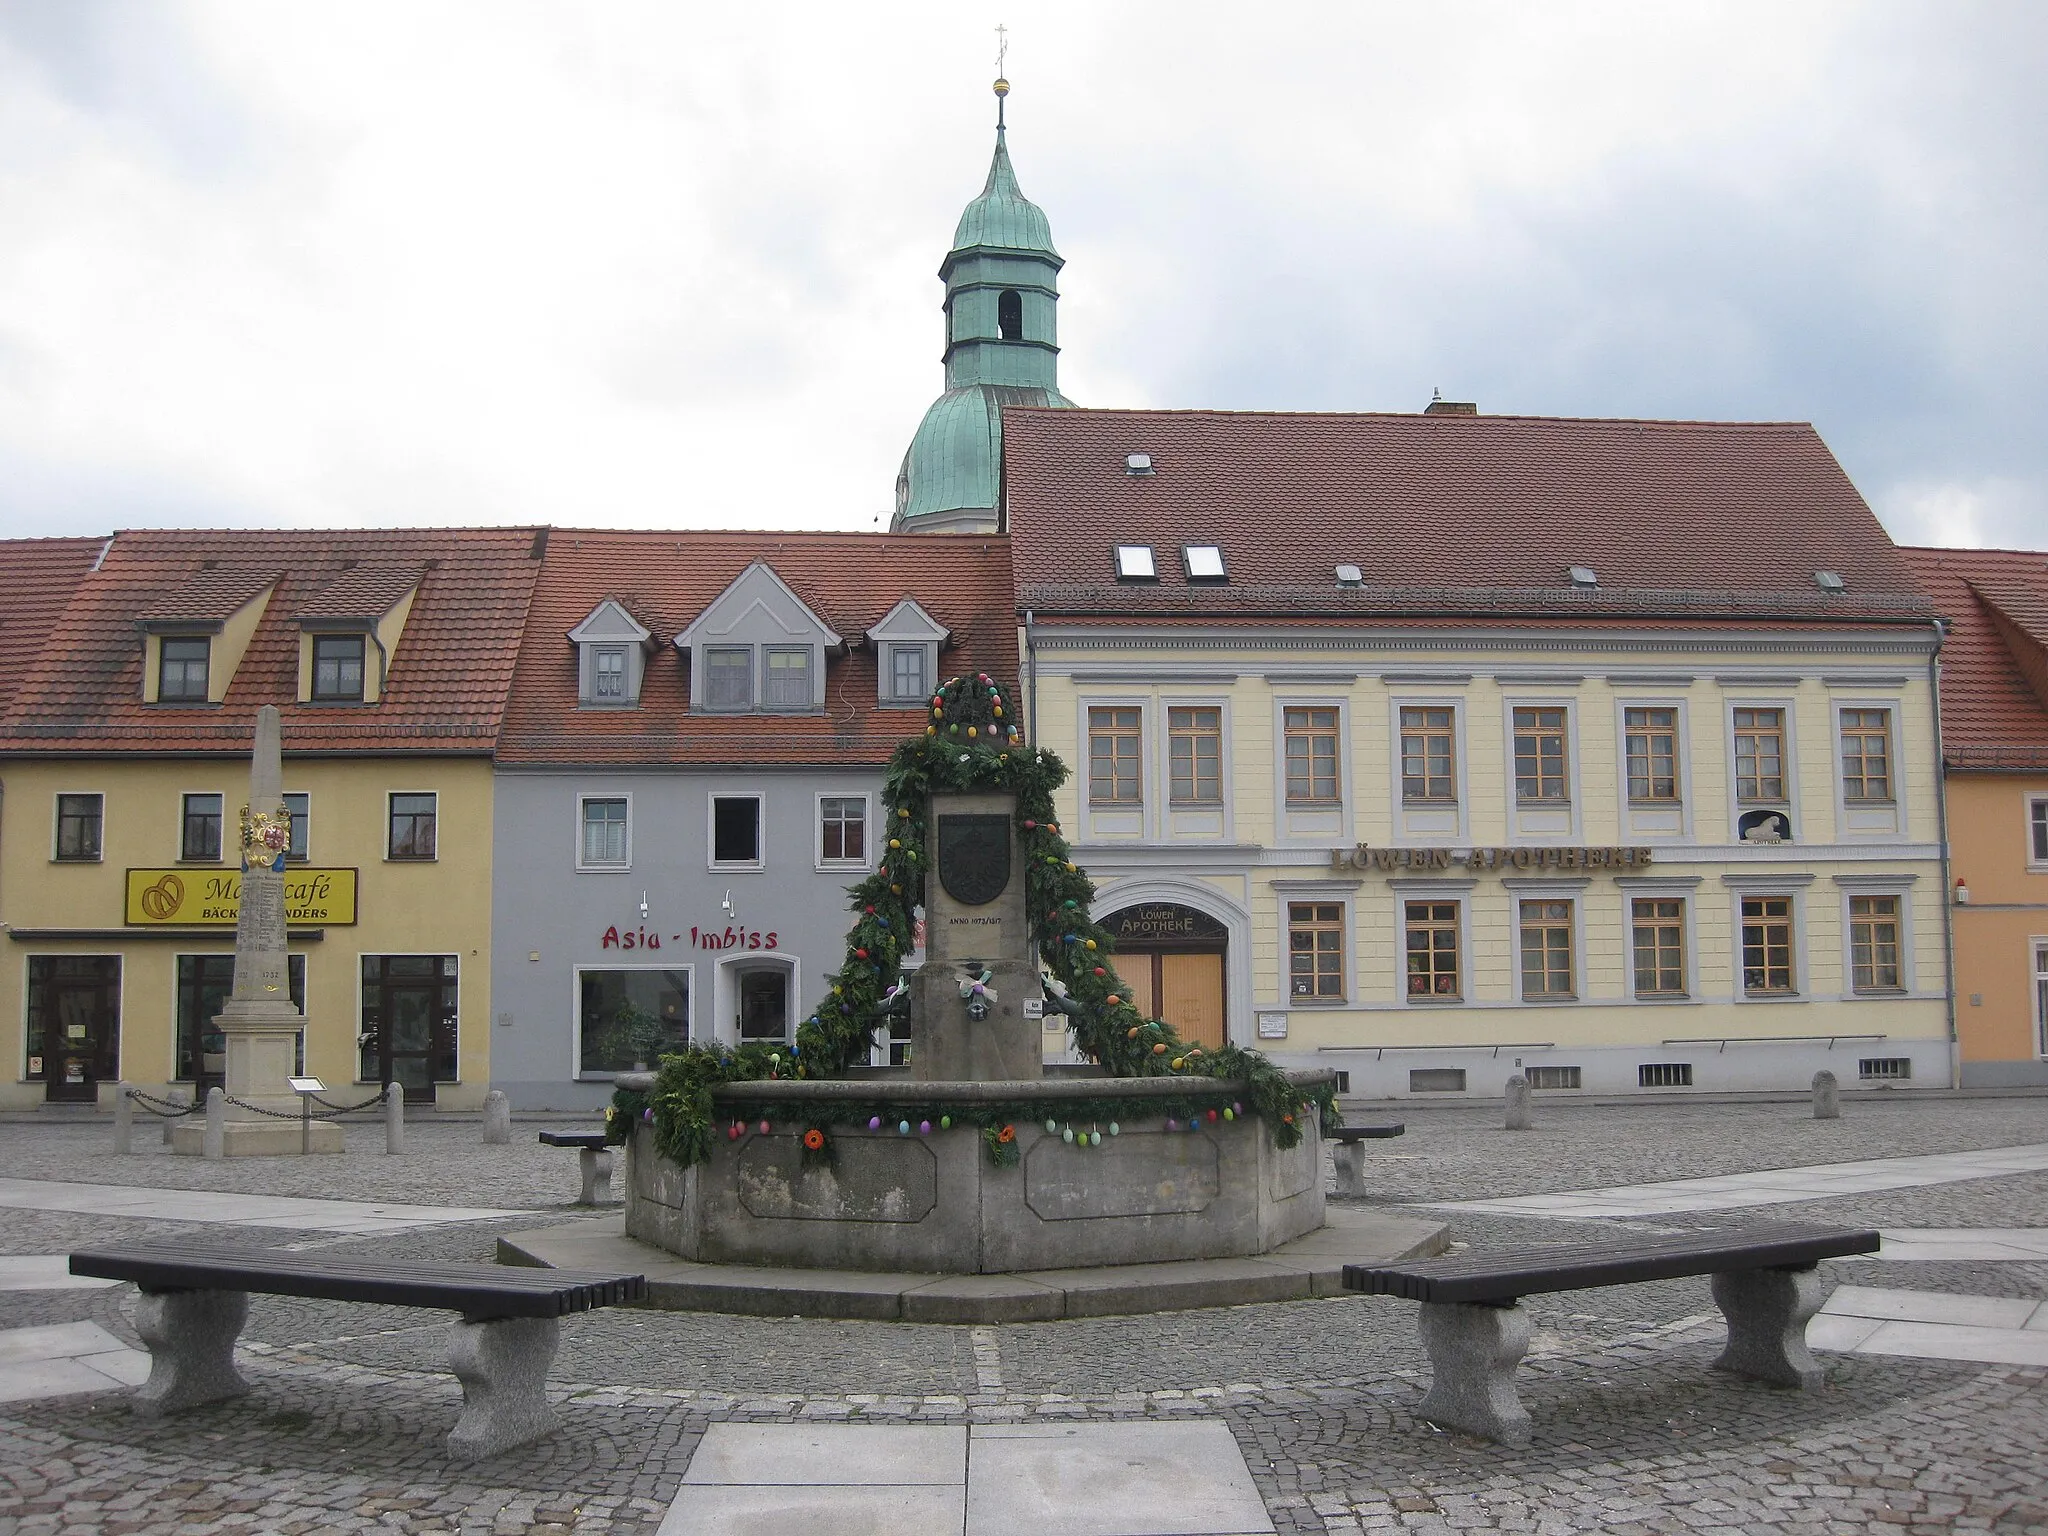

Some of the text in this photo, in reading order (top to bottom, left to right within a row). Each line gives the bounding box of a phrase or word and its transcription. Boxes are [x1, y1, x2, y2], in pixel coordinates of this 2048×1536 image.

[204, 874, 331, 908] Macafé
[285, 908, 328, 919] NDERS
[1140, 909, 1174, 920] LÖWEN
[949, 917, 969, 925] ANNO
[1121, 917, 1194, 932] APOTHEKE
[602, 924, 661, 949] Asia
[690, 925, 778, 949] Imbiss
